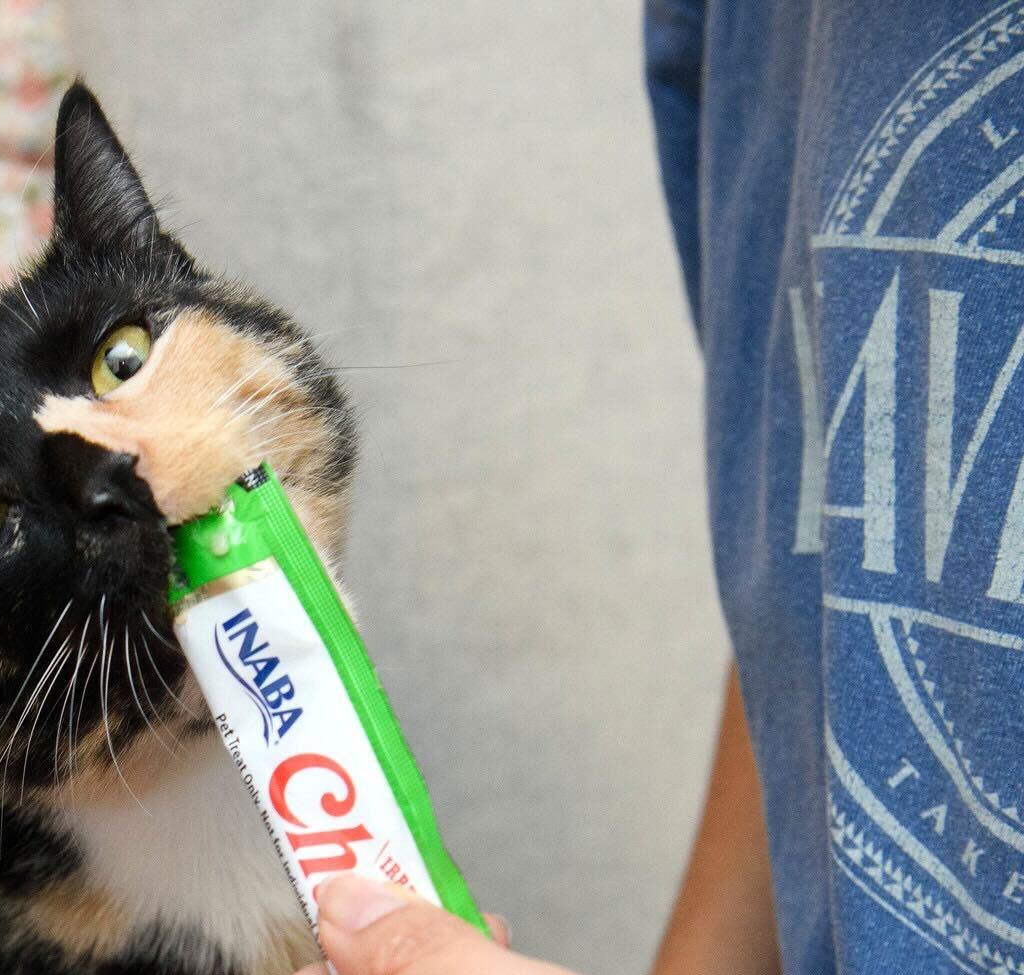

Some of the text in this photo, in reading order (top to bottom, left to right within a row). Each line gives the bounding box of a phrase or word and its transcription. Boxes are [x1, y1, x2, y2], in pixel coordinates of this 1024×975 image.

[222, 608, 304, 738] INABA
[215, 713, 234, 737] Pet
[228, 736, 247, 773] Treat
